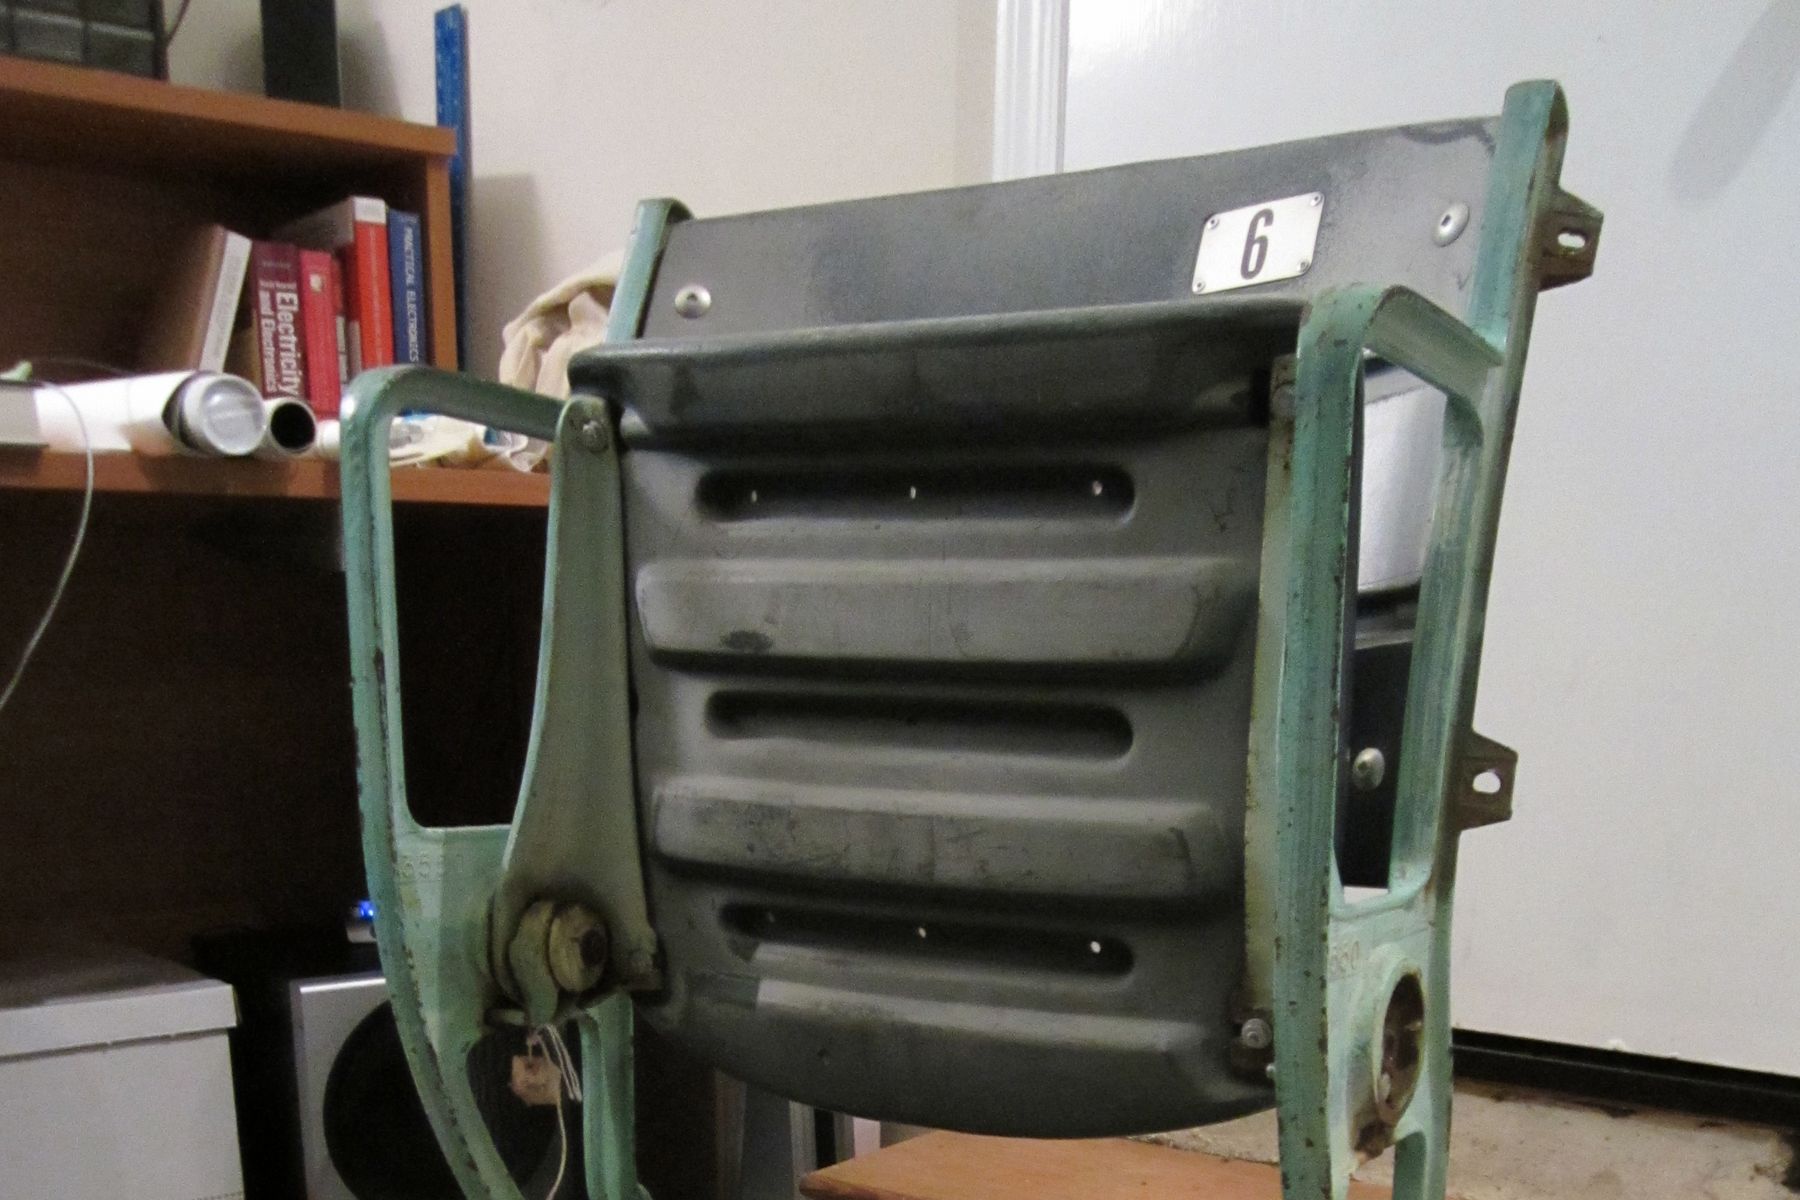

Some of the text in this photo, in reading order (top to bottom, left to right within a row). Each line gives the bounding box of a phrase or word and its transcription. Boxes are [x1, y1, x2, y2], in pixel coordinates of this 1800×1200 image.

[1241, 208, 1274, 280] 6
[258, 290, 278, 393] and Electronics
[276, 291, 302, 397] Electricity
[406, 290, 419, 363] ELECTRONICS
